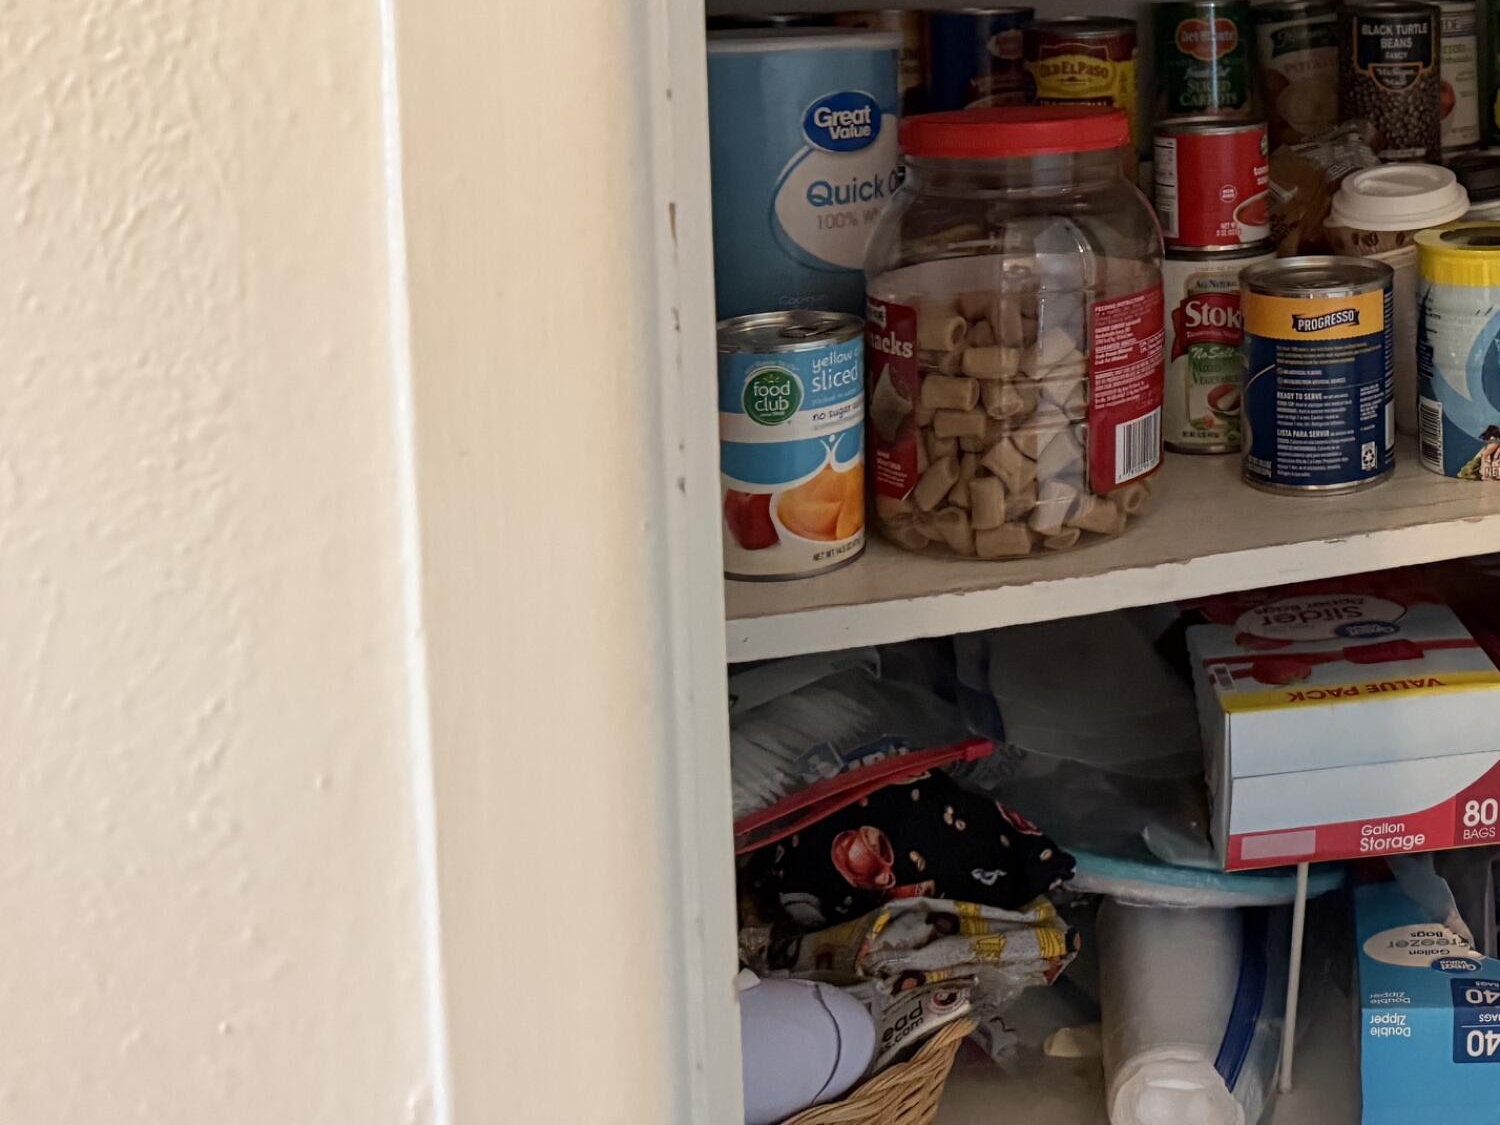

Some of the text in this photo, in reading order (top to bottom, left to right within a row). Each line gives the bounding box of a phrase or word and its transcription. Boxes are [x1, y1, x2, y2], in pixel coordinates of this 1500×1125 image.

[1361, 23, 1428, 36] BLACK TURTLE
[1380, 37, 1413, 49] BEANS
[812, 105, 872, 130] Great
[828, 123, 872, 141] Value
[806, 177, 884, 209] Quick
[816, 212, 859, 230] 100%
[1297, 309, 1355, 331] PROGRESSO
[812, 349, 852, 374] yellow
[811, 363, 859, 393] sliced
[753, 379, 791, 397] food
[1304, 392, 1323, 400] SERVE
[754, 396, 790, 412] club
[812, 405, 851, 421] no sugar
[1308, 429, 1330, 437] SERVIR
[1263, 605, 1364, 626] Slider
[1288, 677, 1447, 702] VALUE PACK
[1462, 798, 1499, 827] 80
[1360, 820, 1406, 836] Gallon
[1463, 826, 1496, 840] BAGS
[1359, 831, 1426, 853] Storage
[1410, 930, 1444, 939] Bags
[1408, 948, 1450, 956] Gallon
[1370, 1014, 1407, 1024] Zipper
[1370, 1026, 1412, 1037] Double
